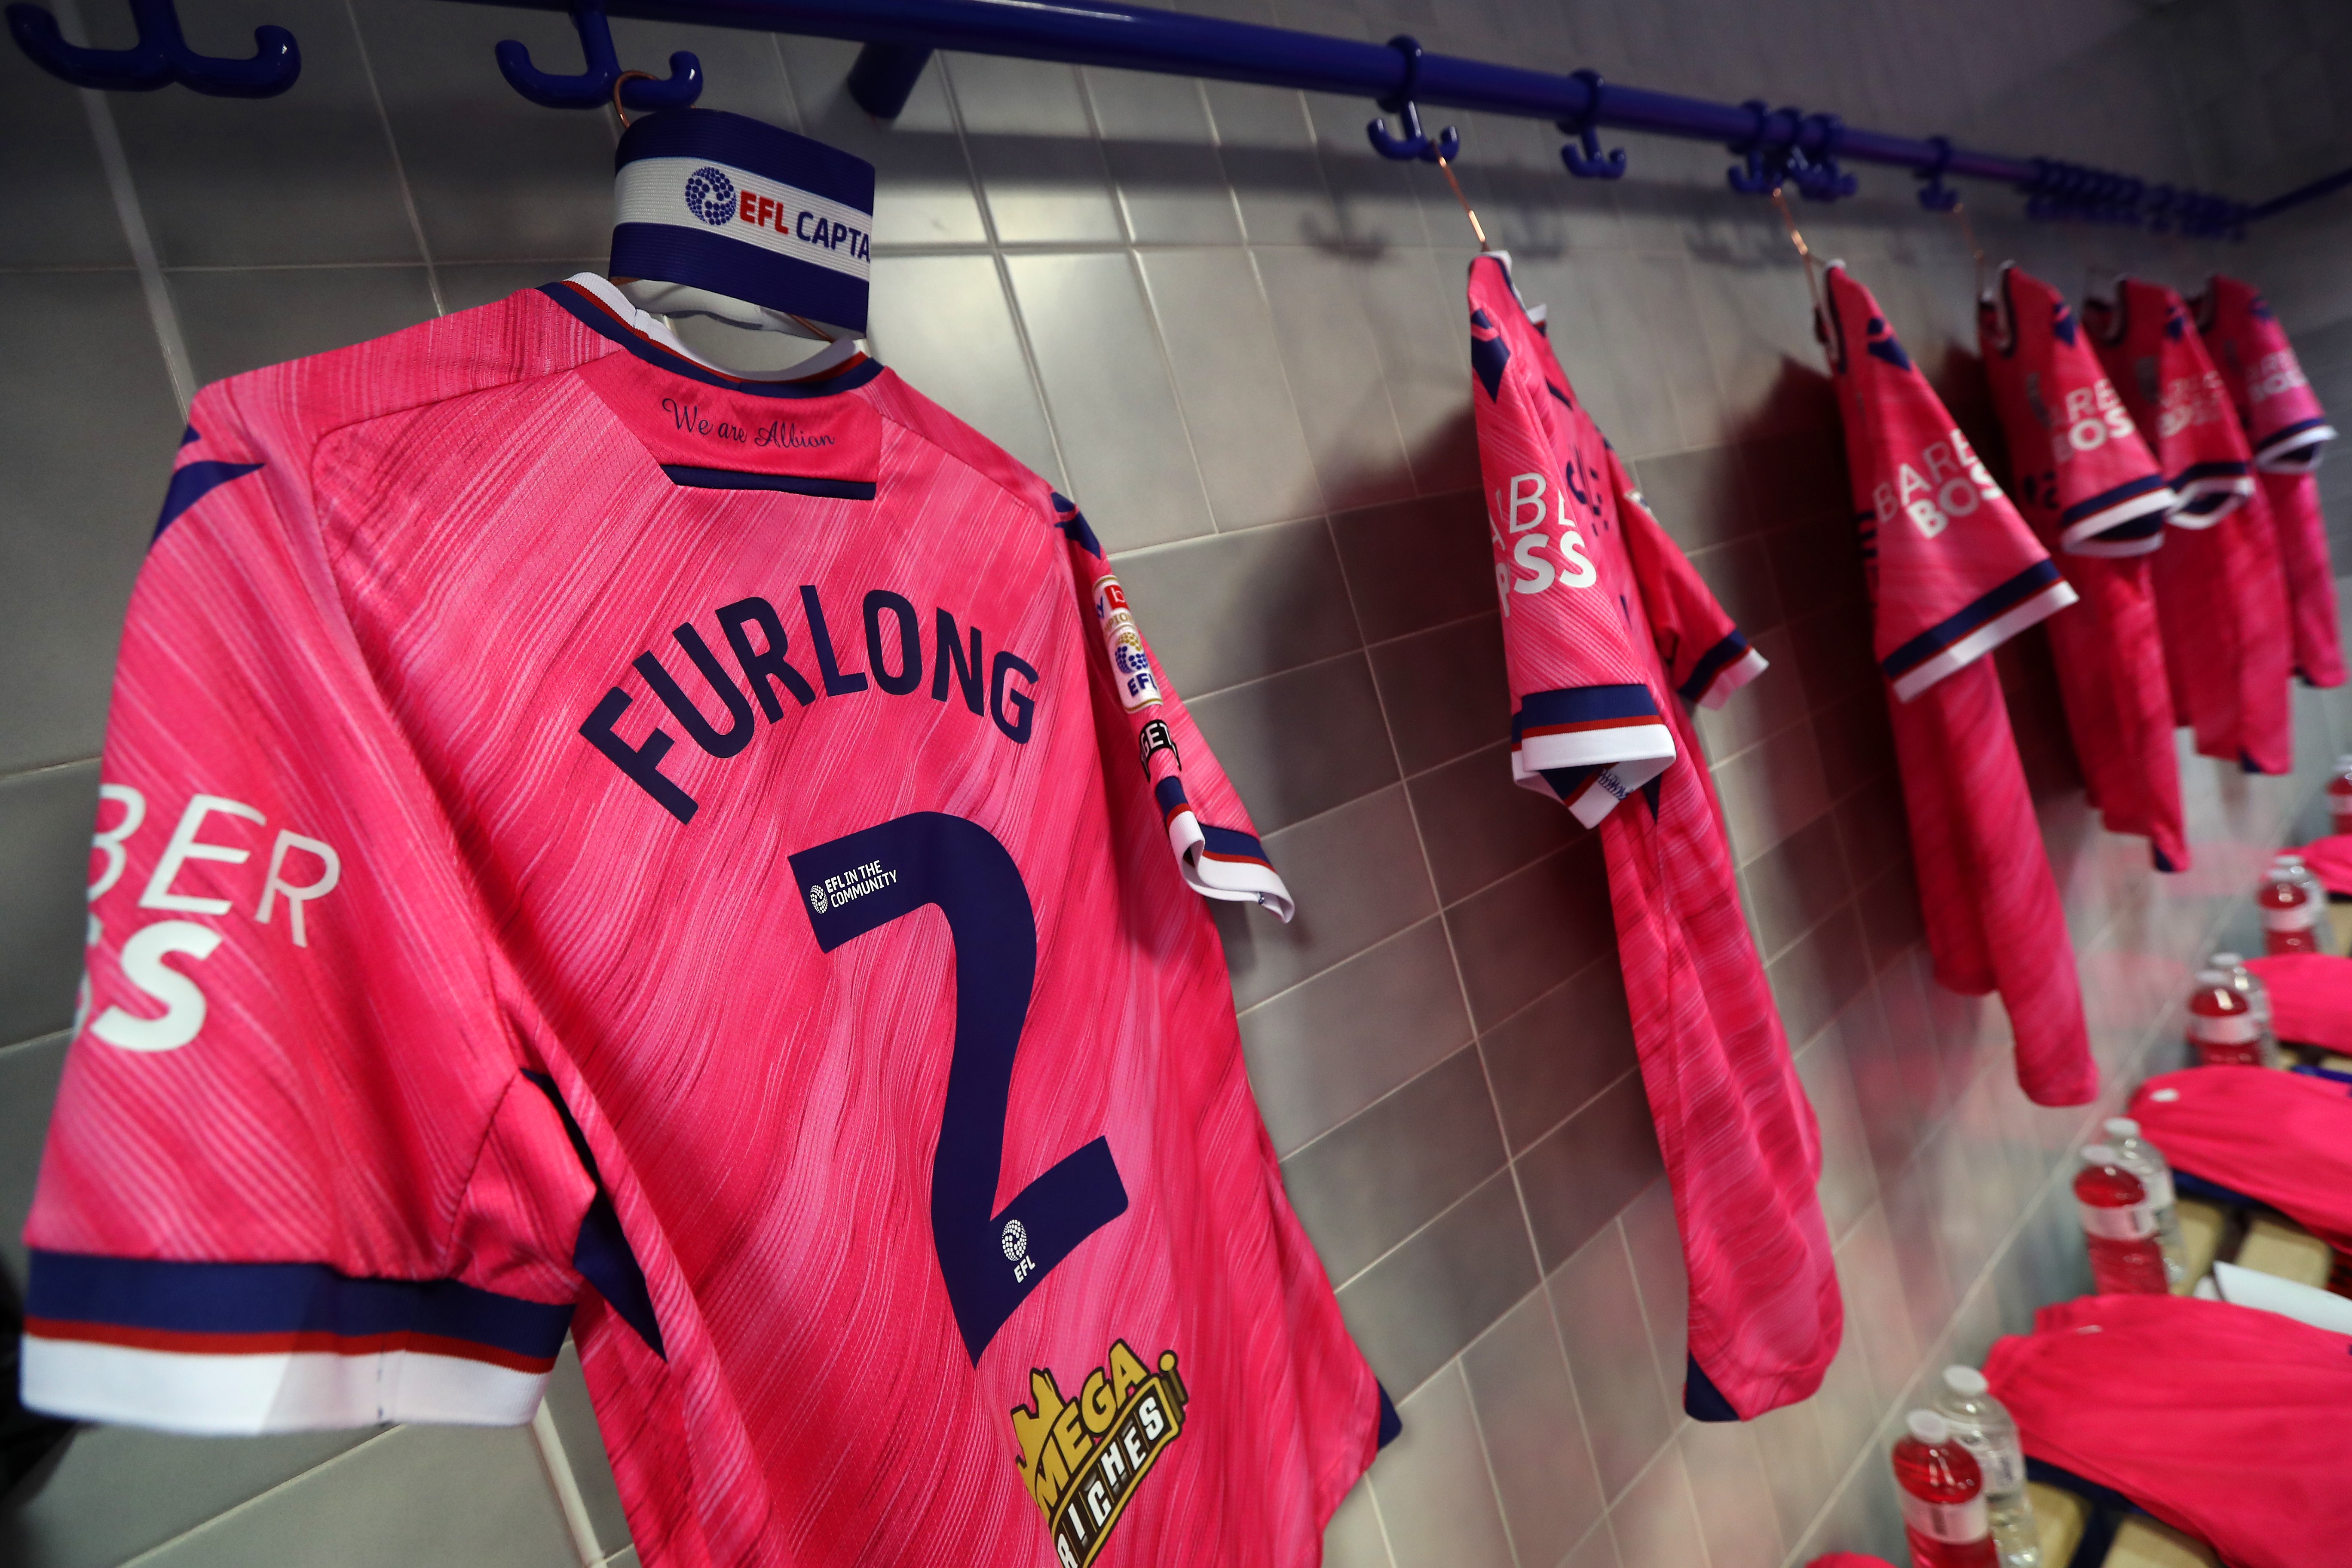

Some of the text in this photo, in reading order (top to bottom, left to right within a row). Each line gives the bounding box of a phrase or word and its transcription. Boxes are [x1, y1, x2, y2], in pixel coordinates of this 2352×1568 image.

[739, 190, 870, 263] EFL CAPTA
[662, 398, 836, 449] We are Albion
[578, 585, 1039, 826] FURLONG
[825, 860, 882, 894] EFL IN THE
[830, 870, 897, 908] COMMUNITY
[787, 811, 1129, 1370] 2
[1013, 1255, 1035, 1283] EFL
[1034, 1338, 1149, 1522] MEGA
